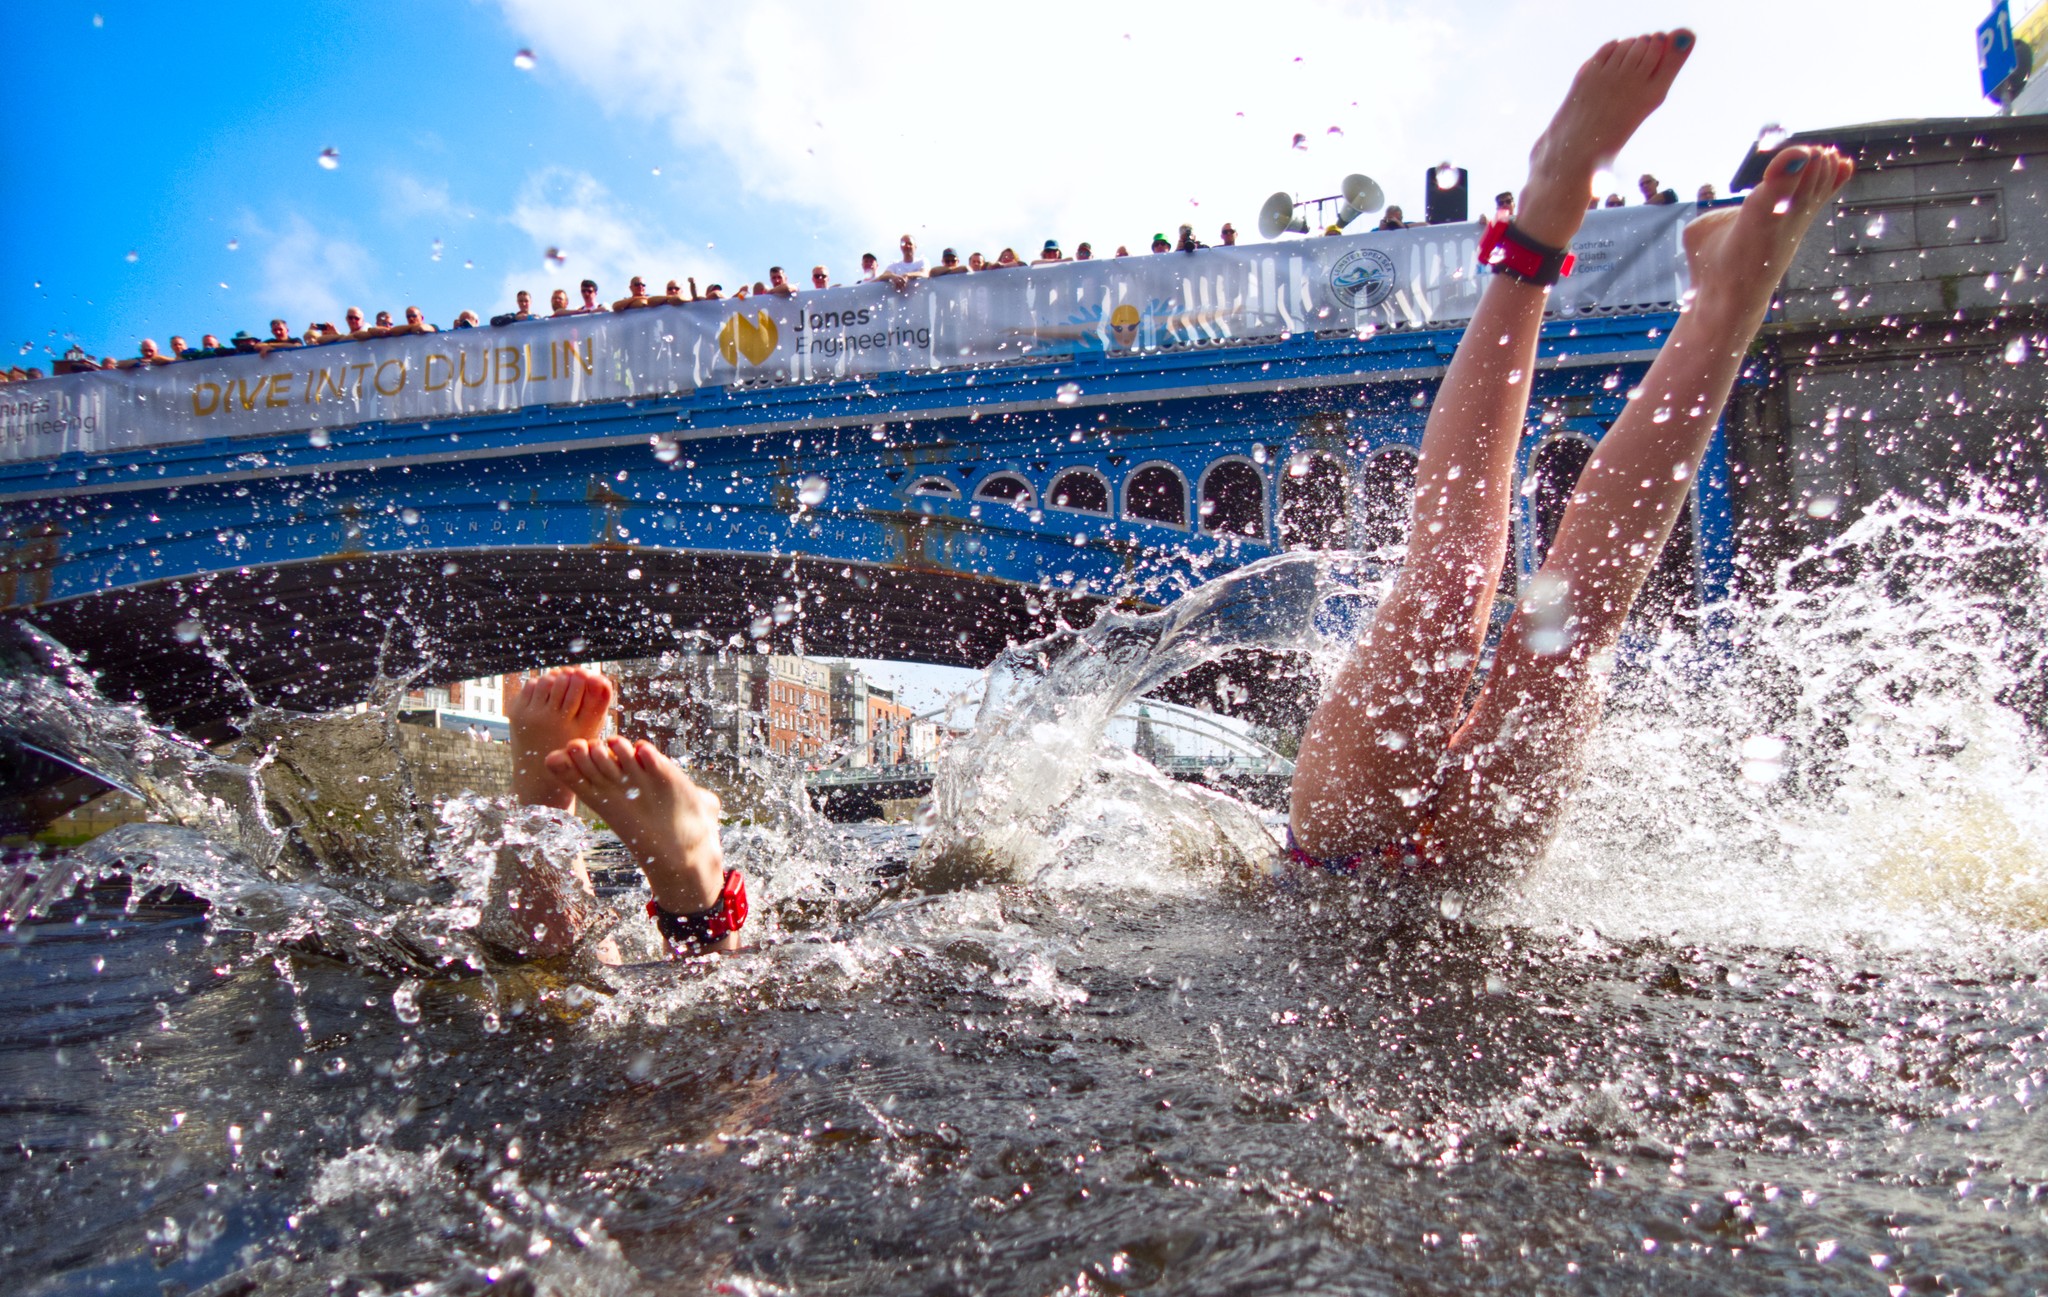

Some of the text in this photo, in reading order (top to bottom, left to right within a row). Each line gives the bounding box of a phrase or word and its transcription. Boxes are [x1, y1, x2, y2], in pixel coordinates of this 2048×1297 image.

[1362, 251, 1383, 260] OPEN
[1381, 259, 1392, 273] SEA
[1578, 263, 1615, 273] Council
[794, 308, 870, 332] Jones
[795, 327, 930, 358] Engineering
[191, 338, 593, 416] DIVE INTO DUBLIN
